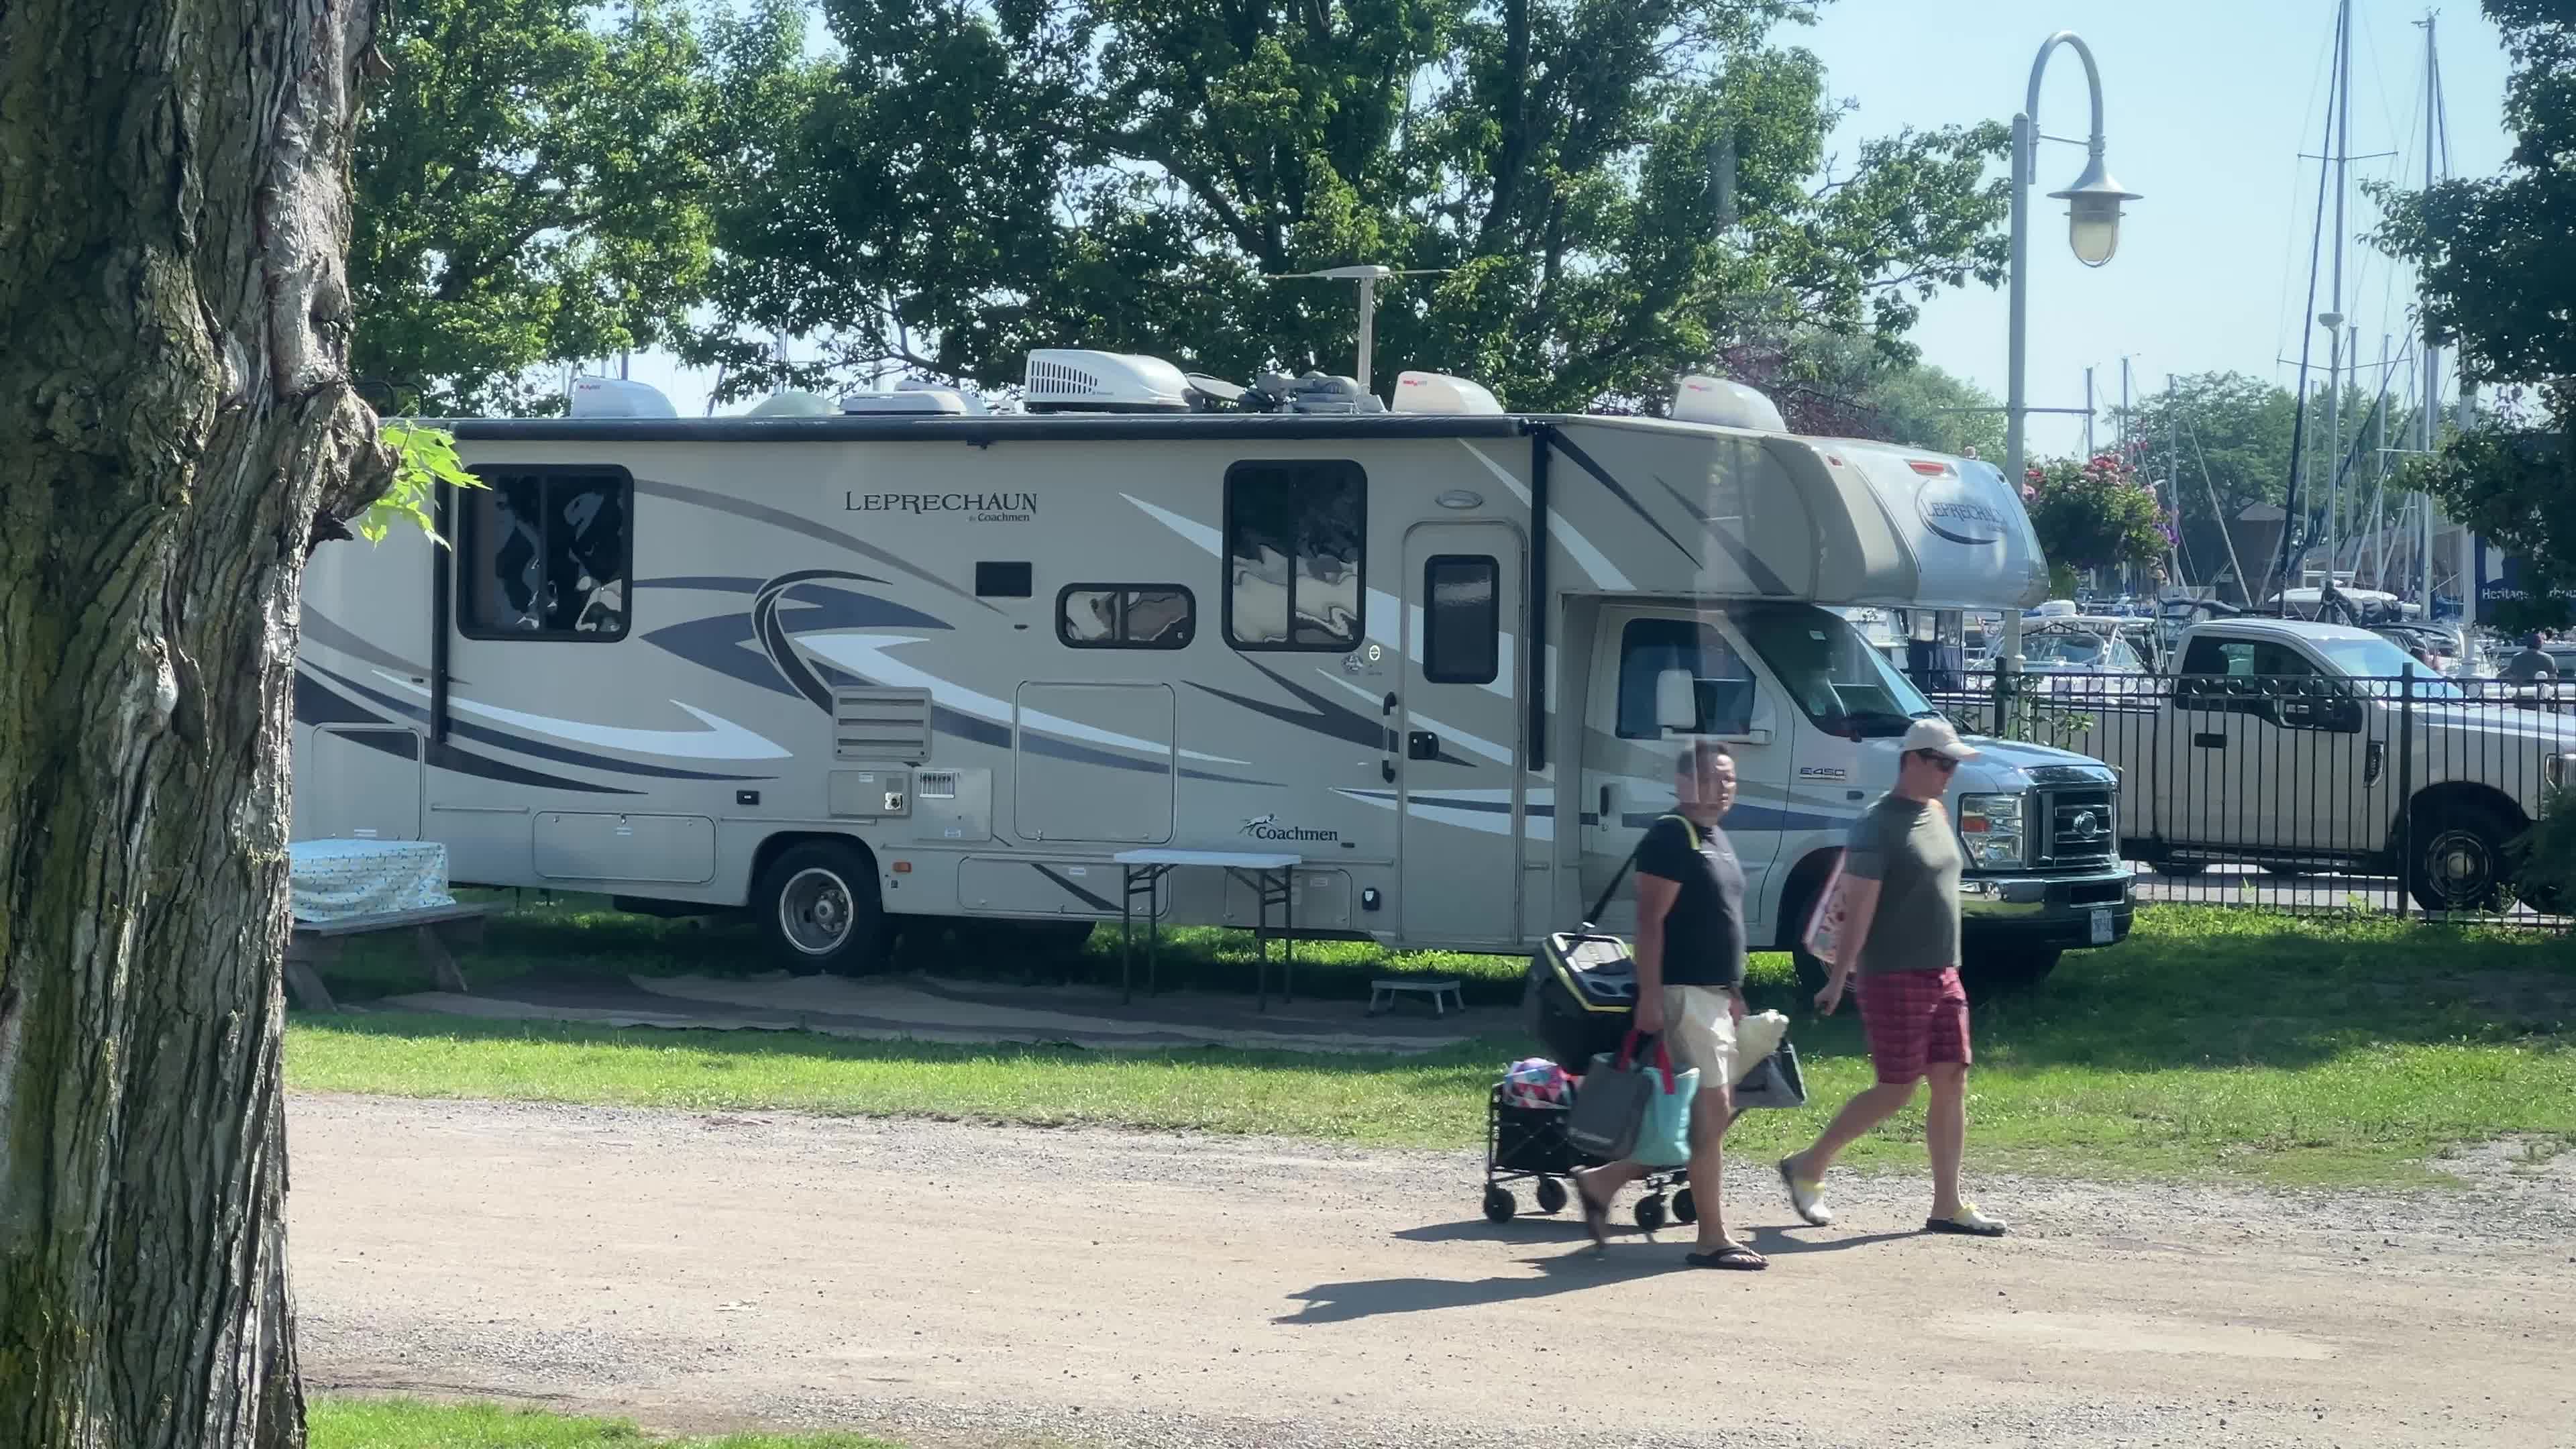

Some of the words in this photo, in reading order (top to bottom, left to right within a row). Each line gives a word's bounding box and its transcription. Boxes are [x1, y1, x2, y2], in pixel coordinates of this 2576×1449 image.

[845, 491, 1037, 514] LEPRECHAUN
[978, 513, 1030, 521] Coachmen
[1256, 826, 1338, 841] Coachmen
